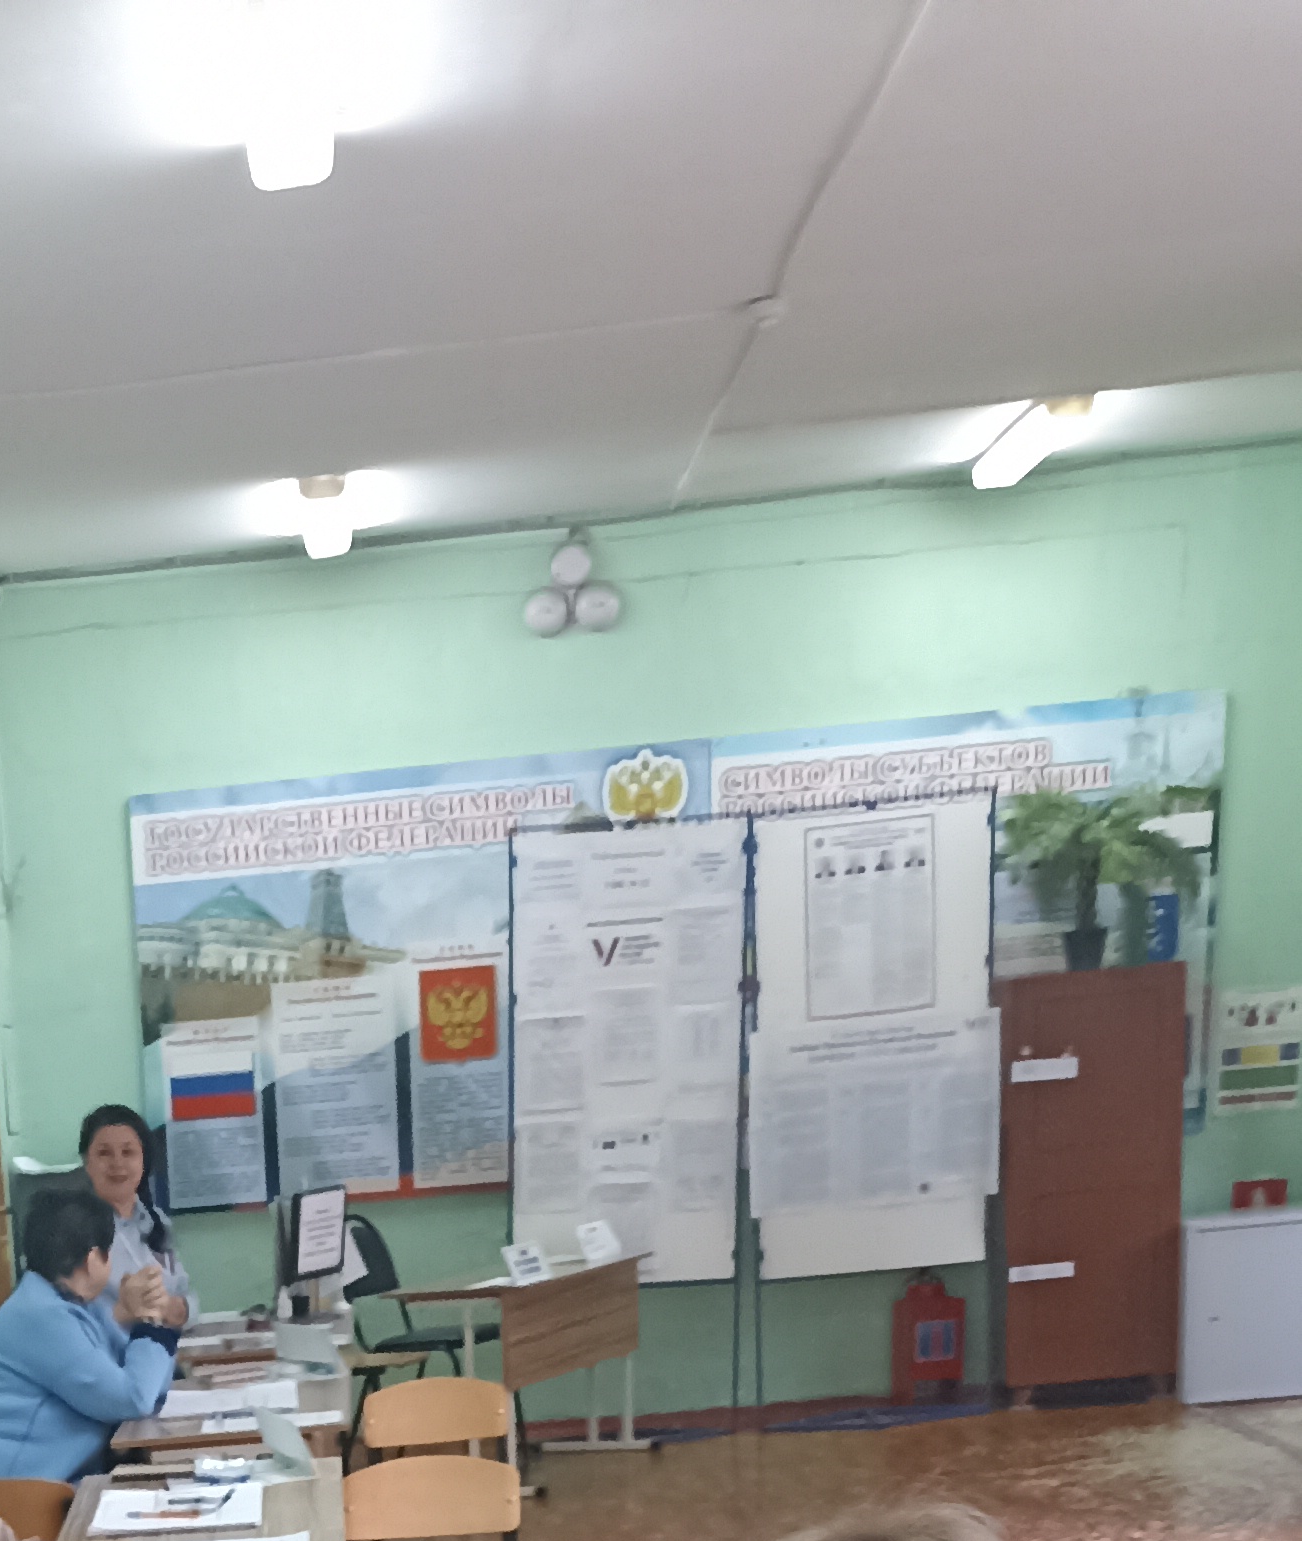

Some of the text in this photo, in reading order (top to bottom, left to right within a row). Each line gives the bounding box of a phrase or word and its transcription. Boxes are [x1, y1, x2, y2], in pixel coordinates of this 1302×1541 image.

[723, 756, 871, 794] СИМВОЛЫ
[148, 785, 571, 849] ГОСУДАРСТВЕННЫЕ СИМВОЛЫ
[150, 832, 340, 873] РОССИЙСКОЙ
